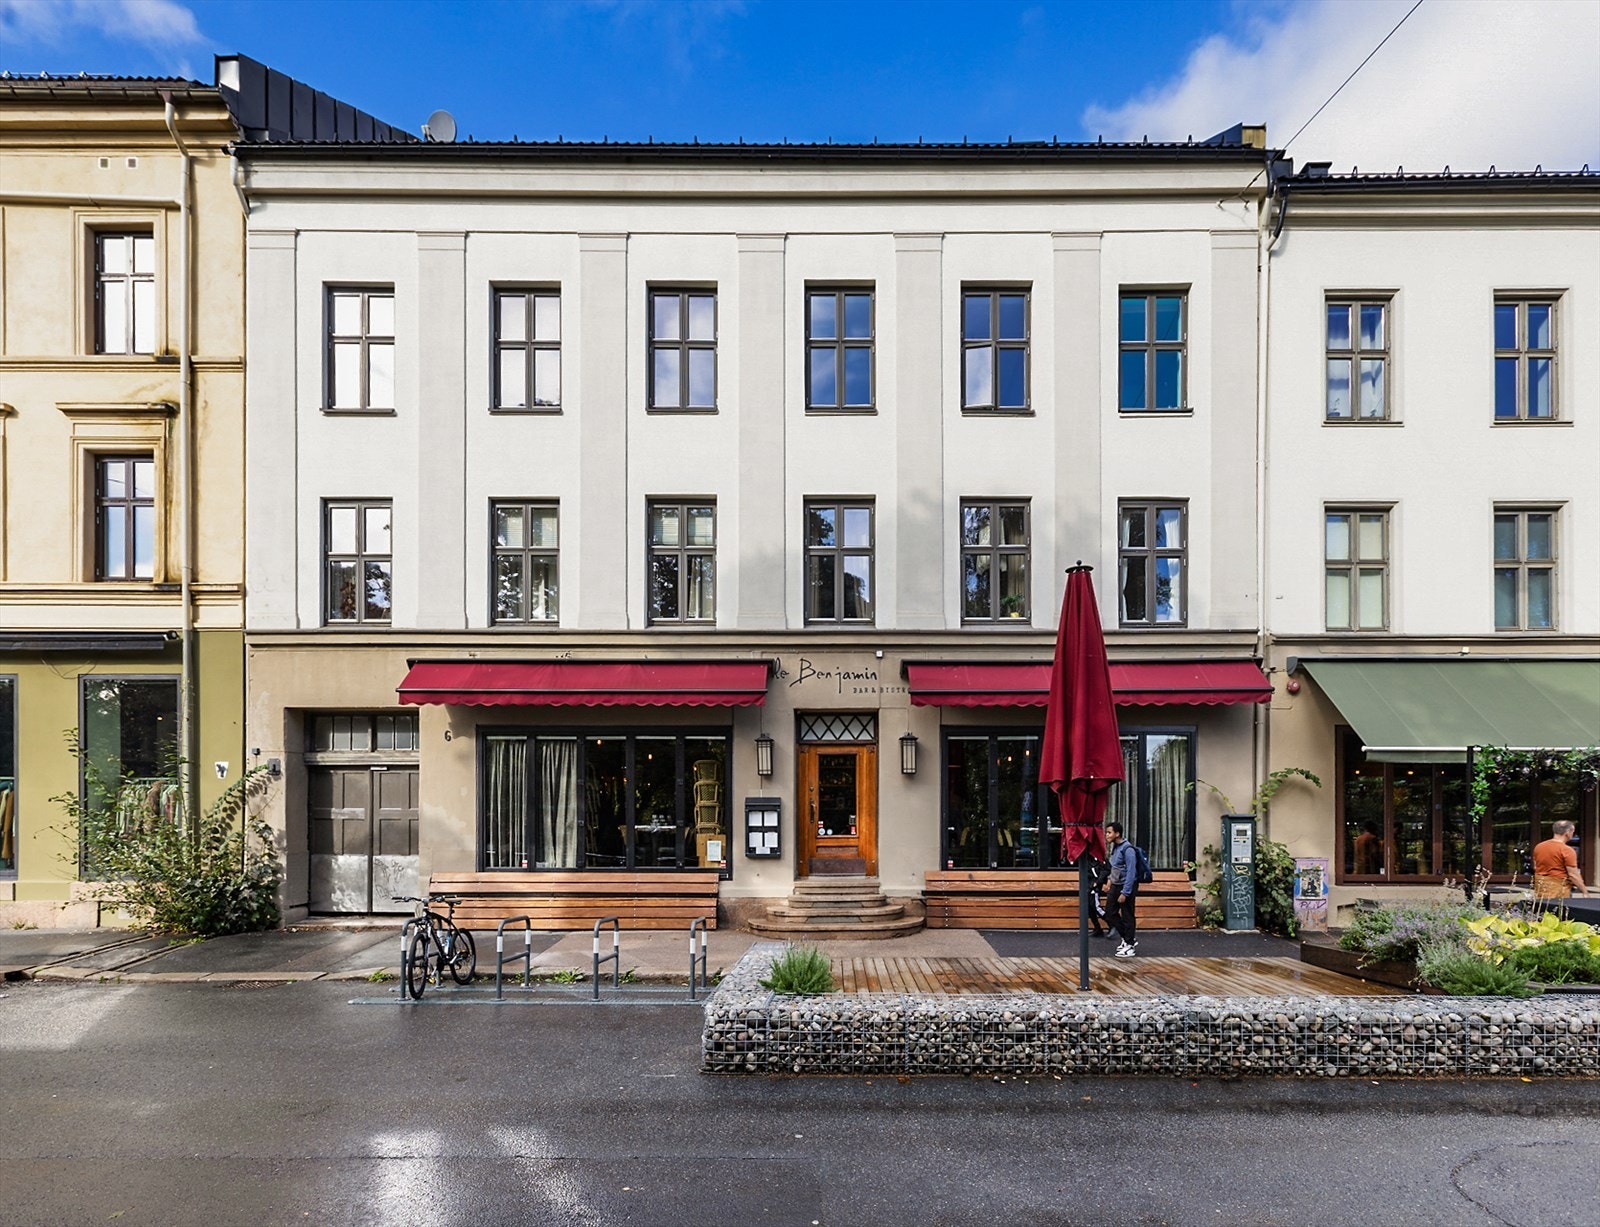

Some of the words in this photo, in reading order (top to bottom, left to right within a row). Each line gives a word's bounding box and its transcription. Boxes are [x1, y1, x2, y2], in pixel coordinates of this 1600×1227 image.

[789, 657, 878, 694] Benjamin
[853, 686, 868, 694] BAR
[444, 730, 452, 742] 6
